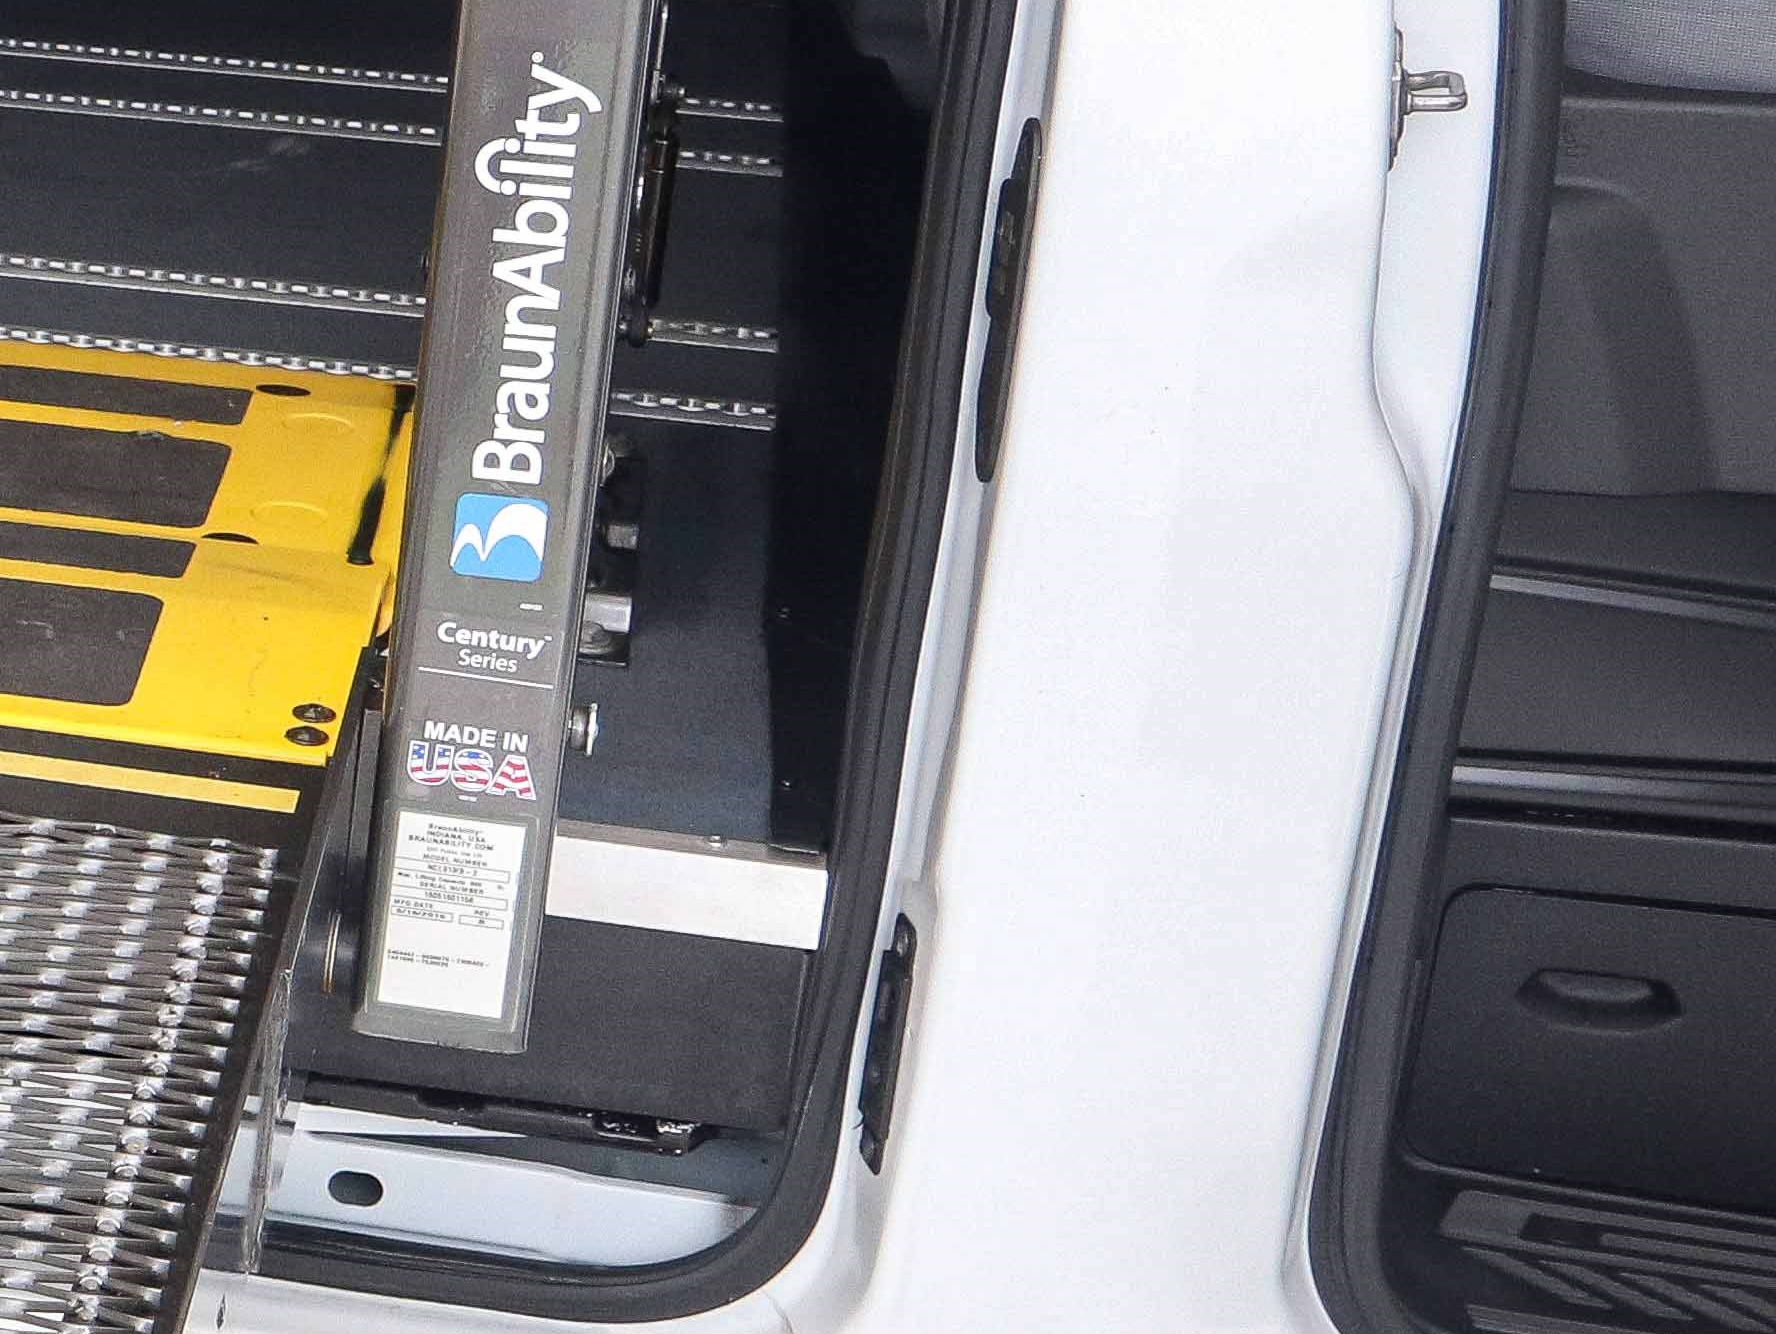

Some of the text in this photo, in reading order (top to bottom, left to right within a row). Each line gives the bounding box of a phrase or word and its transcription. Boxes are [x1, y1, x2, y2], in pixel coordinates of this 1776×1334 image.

[437, 620, 547, 661] Century
[457, 648, 518, 673] Series
[423, 720, 529, 753] MADE IN
[407, 739, 537, 801] USA
